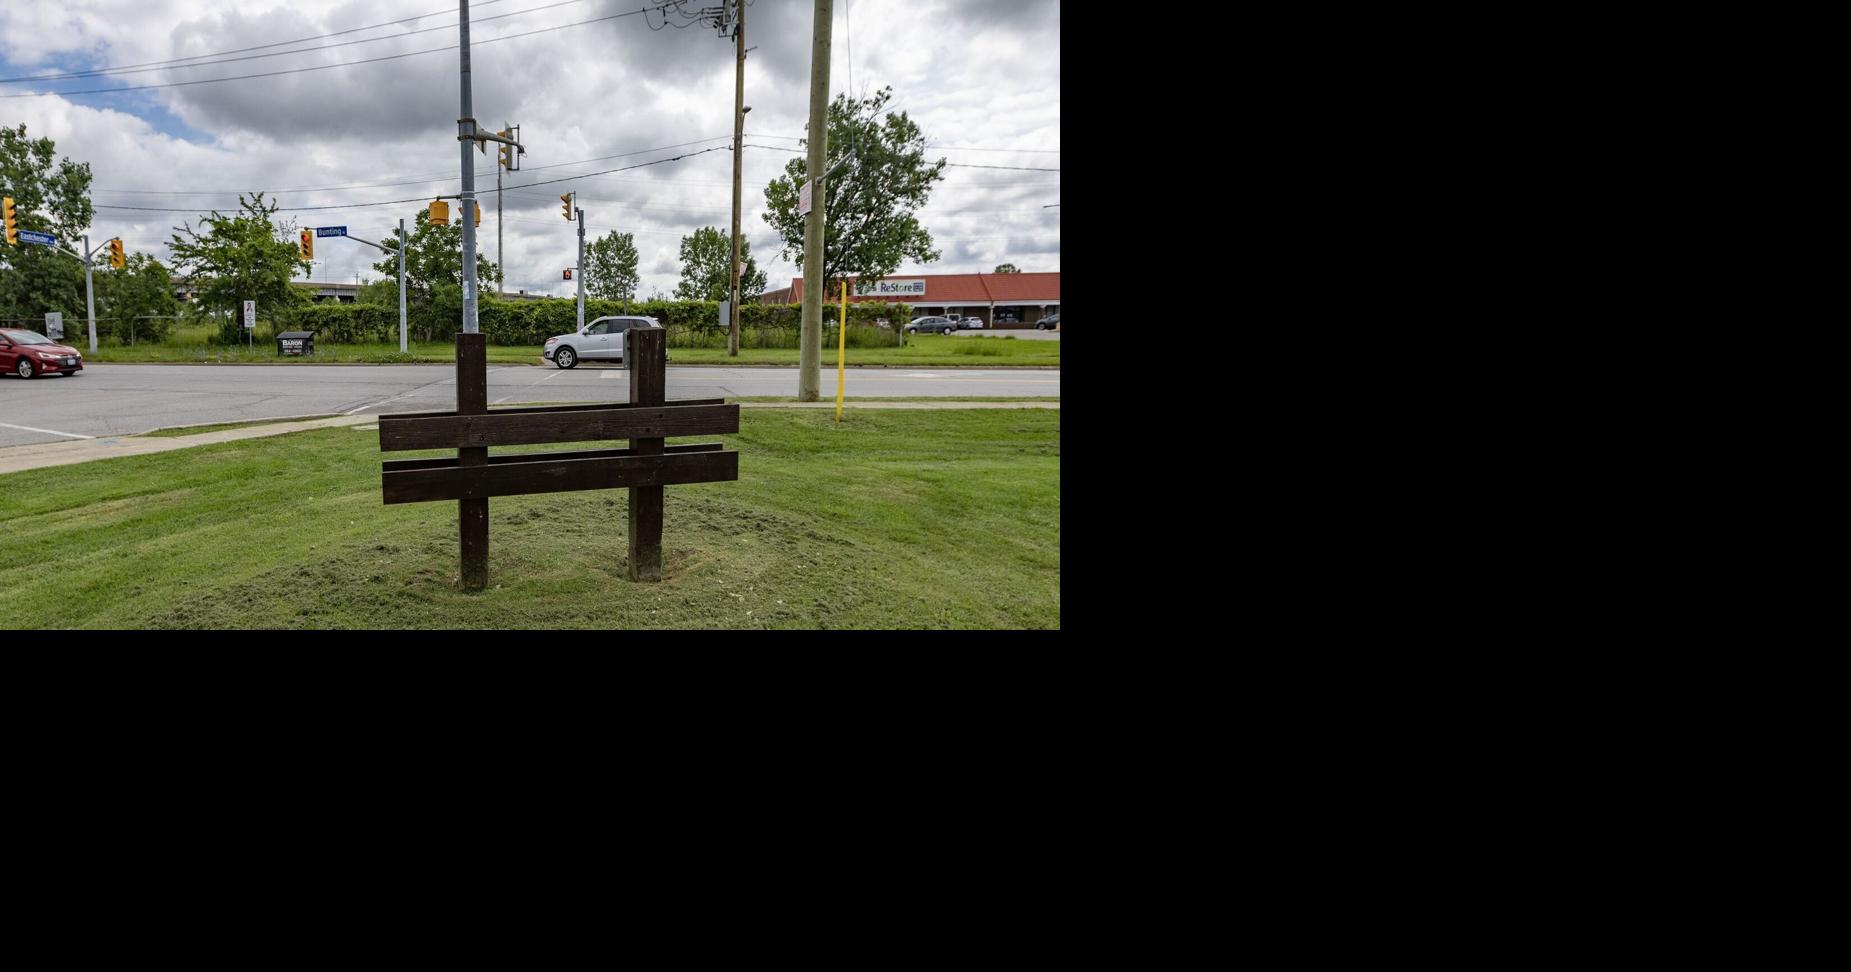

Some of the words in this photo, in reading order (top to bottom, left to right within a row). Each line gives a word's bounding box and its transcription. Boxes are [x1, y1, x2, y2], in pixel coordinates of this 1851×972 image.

[318, 228, 342, 236] Bunting
[20, 232, 49, 242] Eastchester
[880, 283, 913, 292] ReStore
